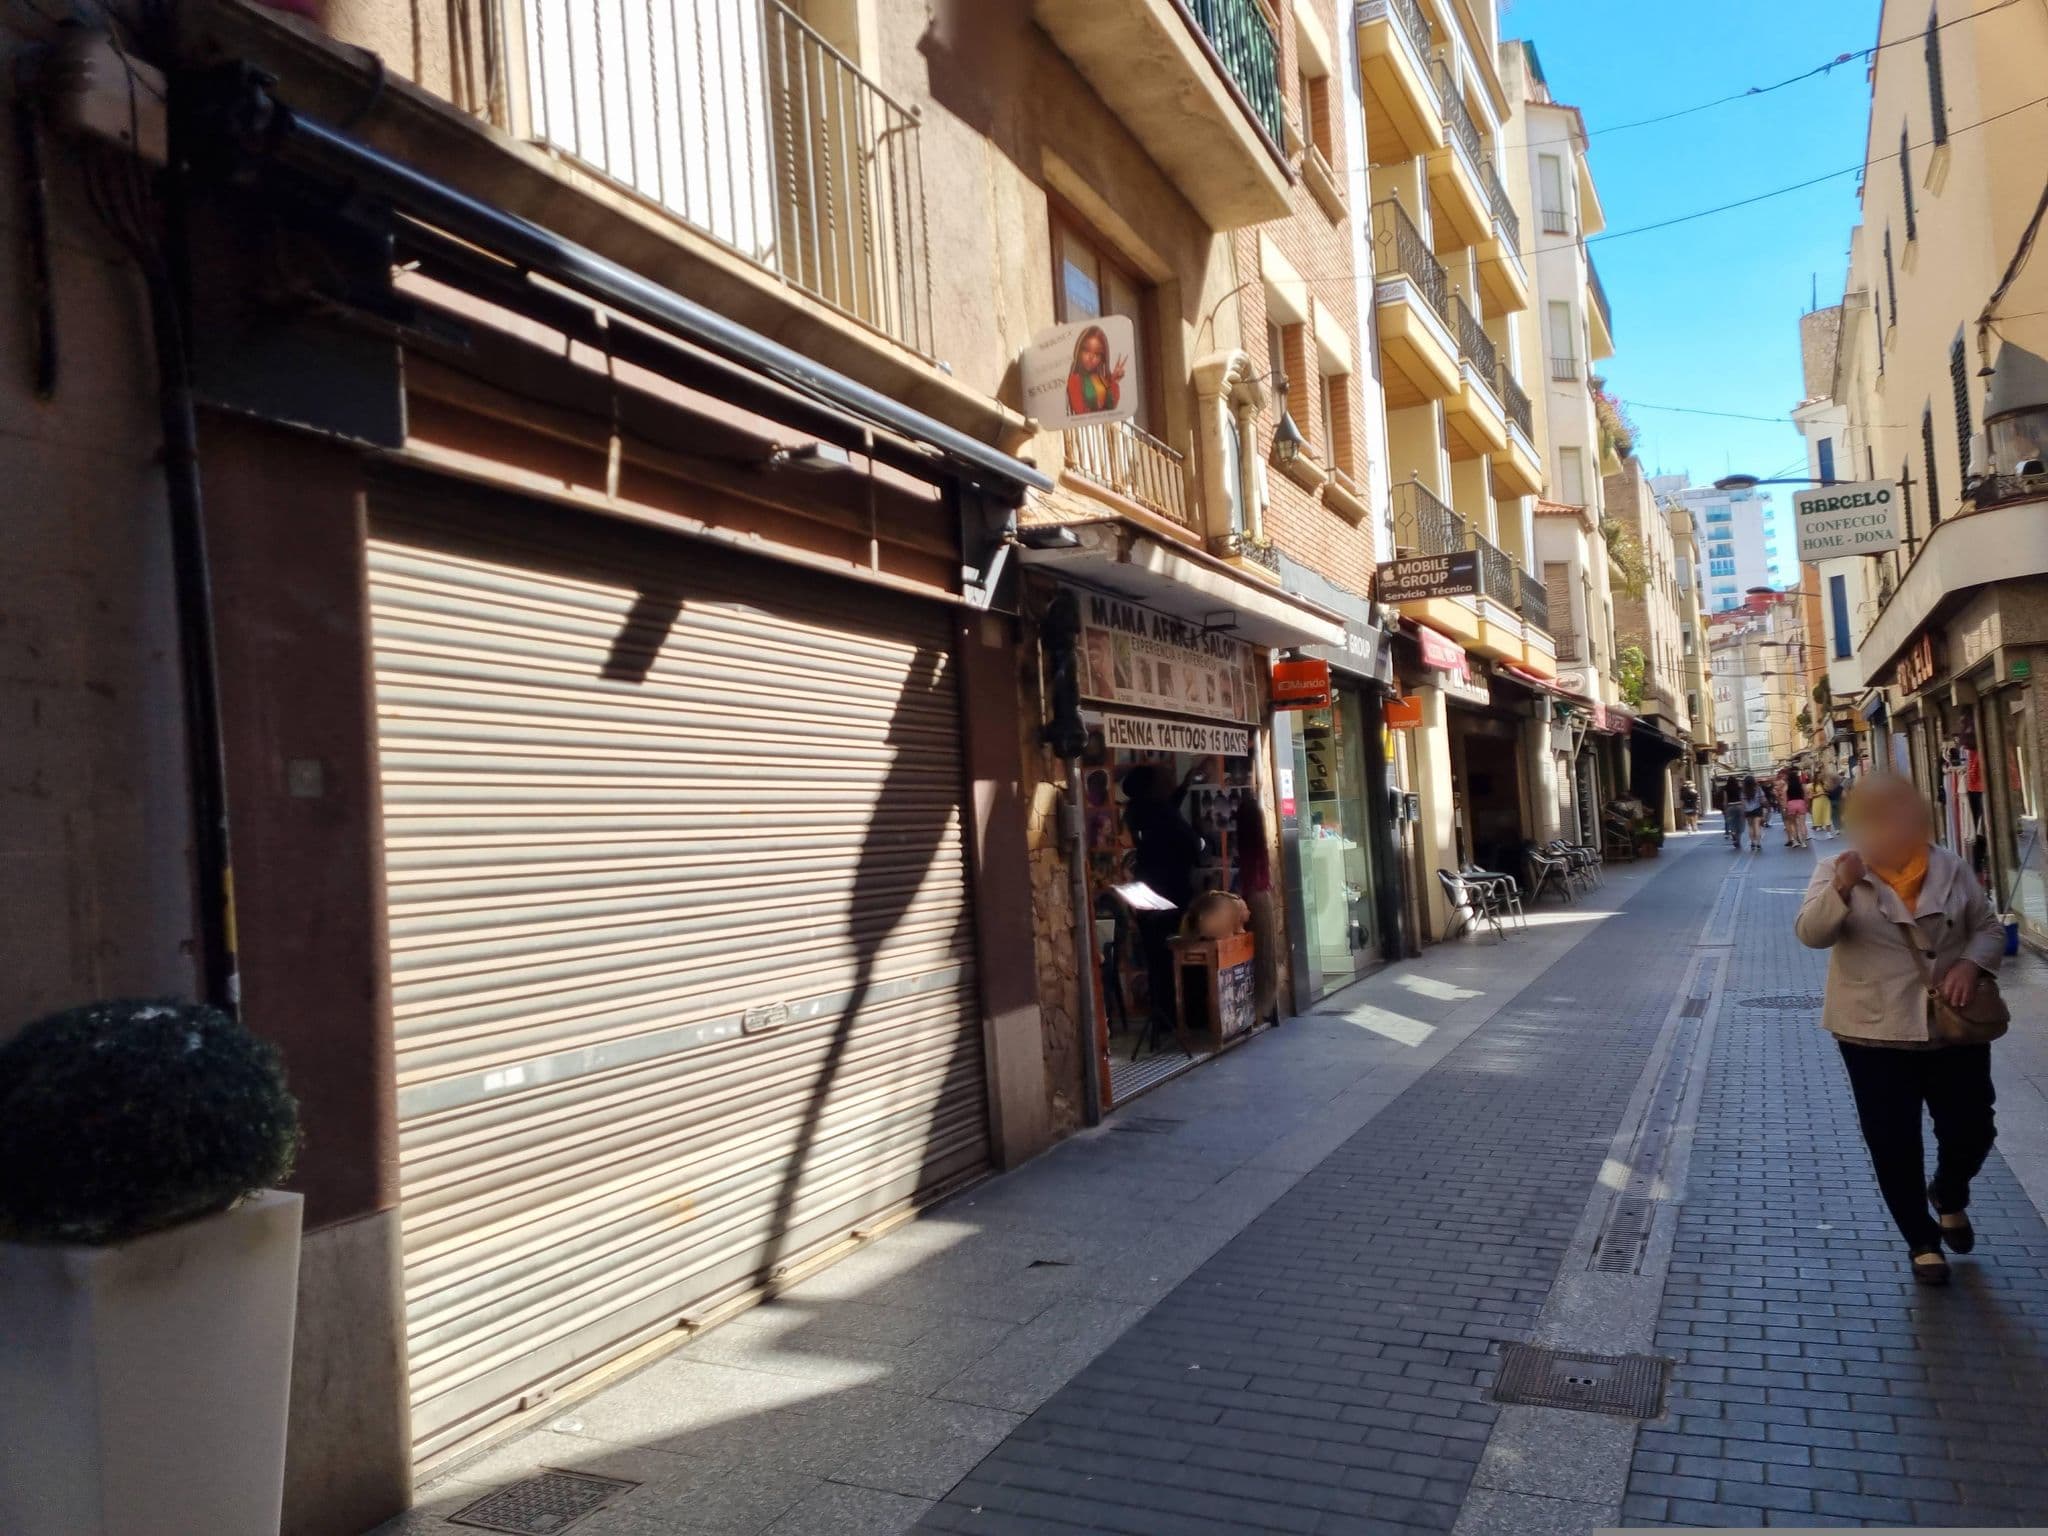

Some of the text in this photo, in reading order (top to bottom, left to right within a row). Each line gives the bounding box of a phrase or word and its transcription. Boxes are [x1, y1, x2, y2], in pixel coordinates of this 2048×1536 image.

[1800, 489, 1890, 515] BARCELO
[1803, 535, 1845, 550] HOME
[1855, 529, 1893, 543] DONA
[1398, 558, 1449, 574] MOBILE
[1401, 571, 1449, 587] GROUP
[1385, 585, 1473, 601] Servicio Técnico
[1091, 597, 1148, 637] MAMA
[1108, 716, 1247, 753] HENNA TATTOOS 15 DAYS
